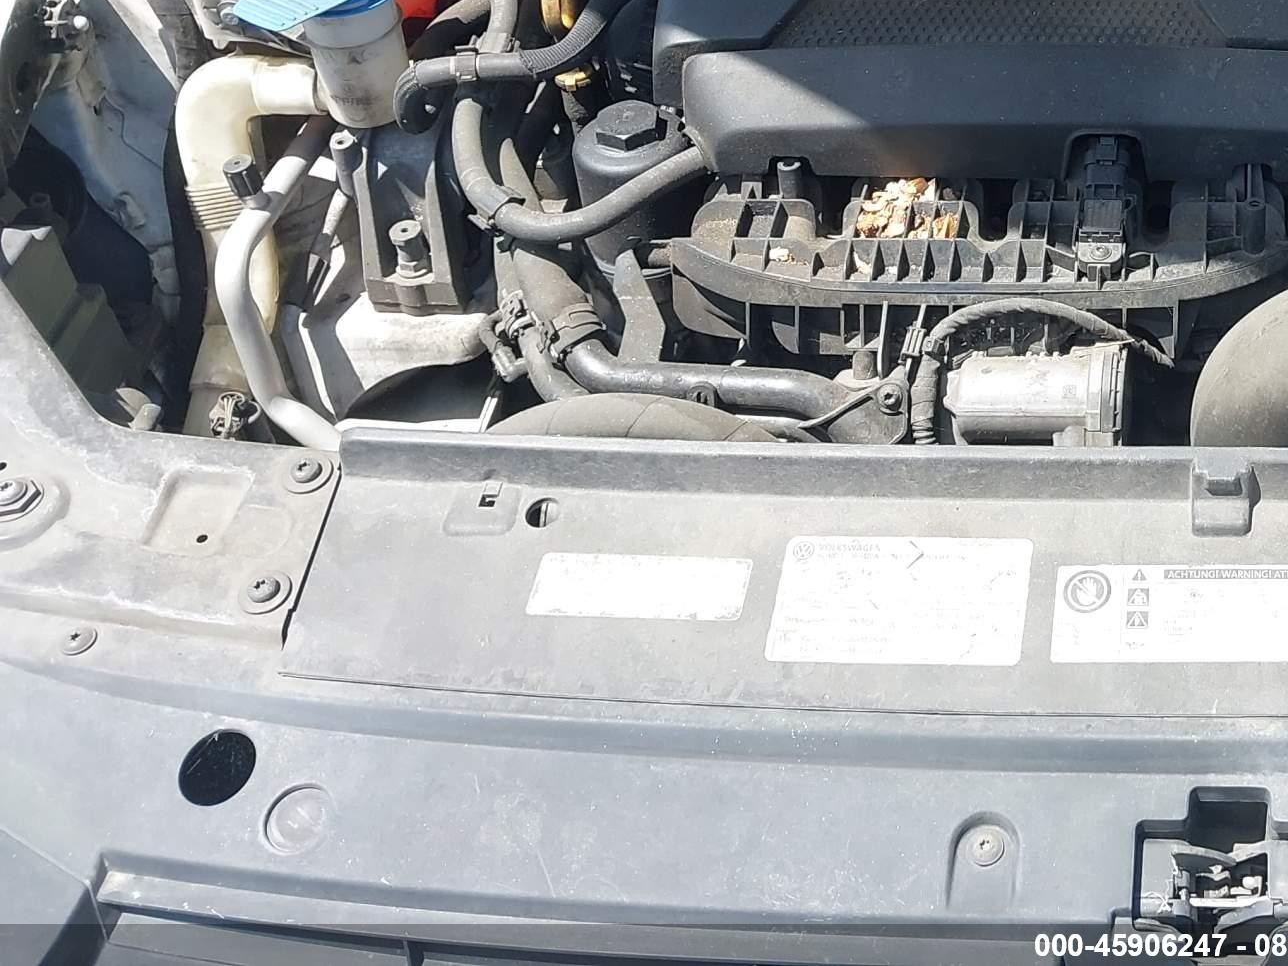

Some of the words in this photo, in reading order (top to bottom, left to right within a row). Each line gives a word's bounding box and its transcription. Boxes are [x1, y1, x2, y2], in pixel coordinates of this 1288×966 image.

[819, 543, 881, 552] VOLKSWAGEN
[1167, 569, 1219, 580] ACHTUNG!
[1220, 569, 1273, 580] WARNING!
